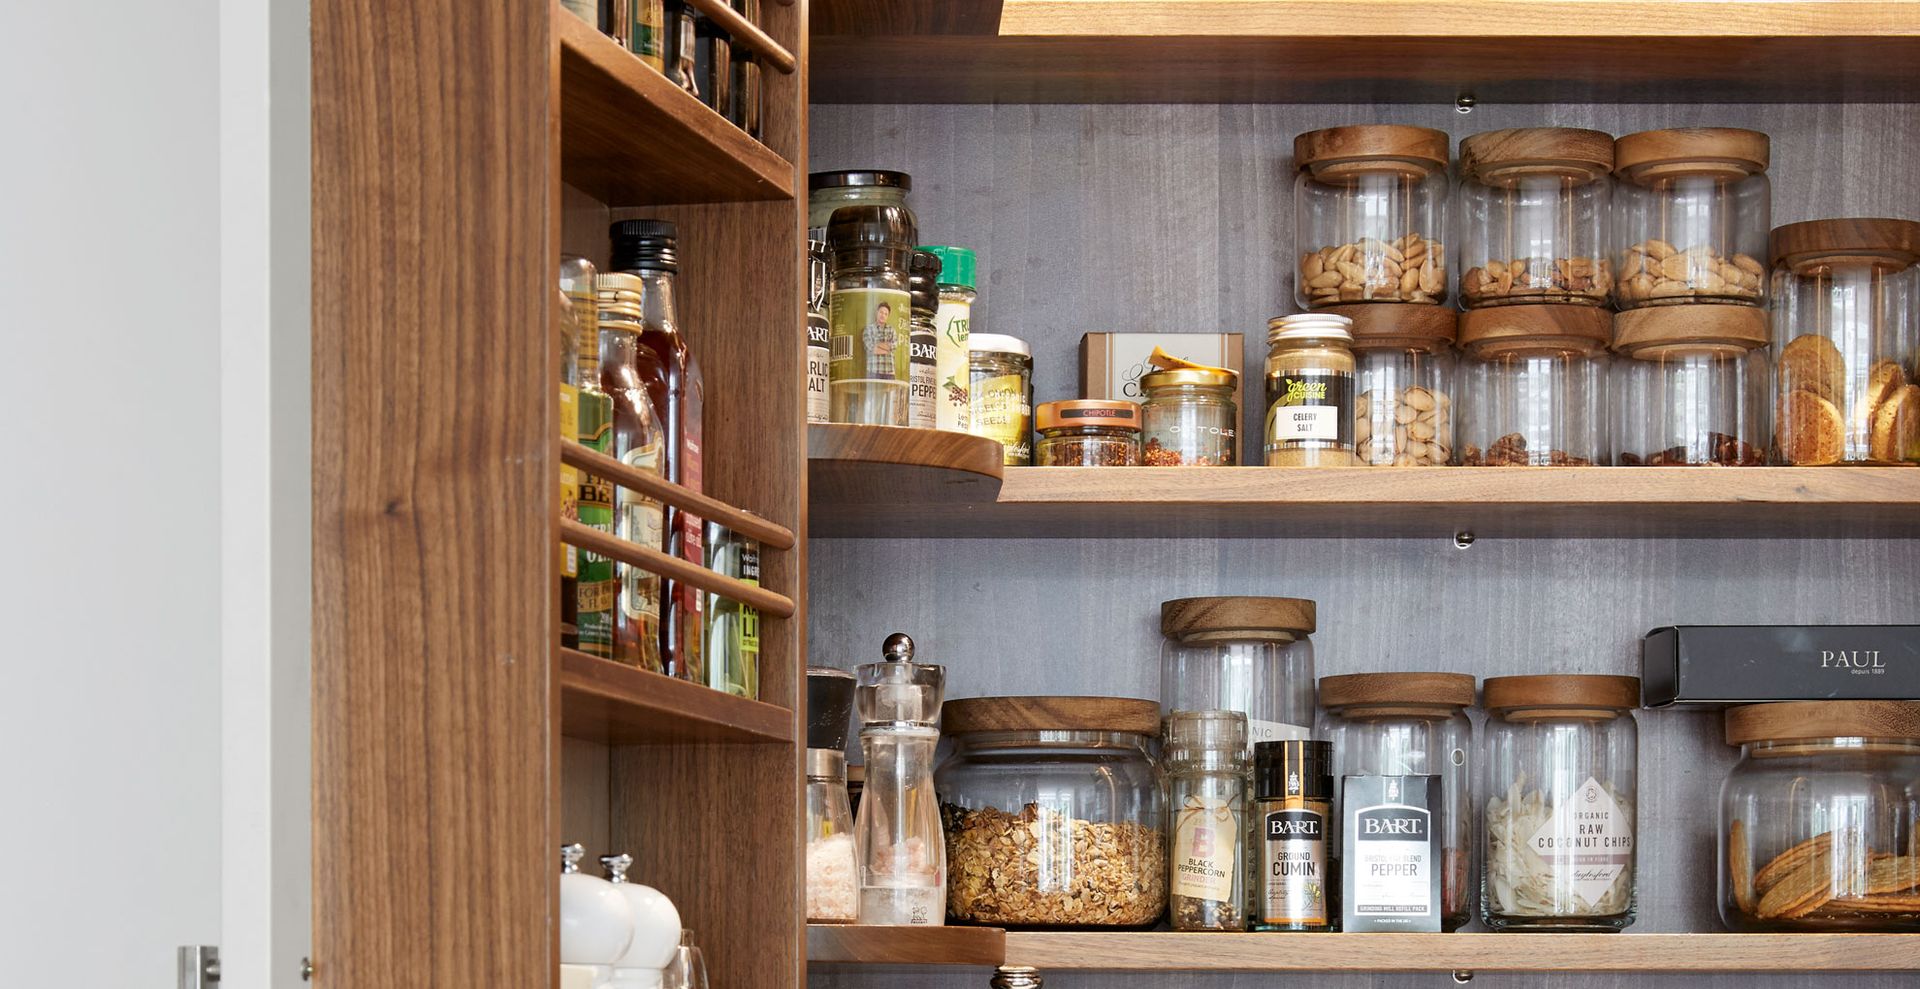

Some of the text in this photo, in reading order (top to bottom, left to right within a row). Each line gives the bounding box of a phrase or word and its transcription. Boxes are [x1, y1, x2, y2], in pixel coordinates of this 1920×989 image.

[807, 326, 829, 344] ART
[911, 342, 936, 359] BAR
[808, 378, 825, 393] ALT
[911, 383, 936, 400] PEPPE
[1287, 379, 1327, 402] green
[1294, 391, 1326, 399] CUISINE
[1293, 413, 1317, 422] CELERY
[1297, 424, 1312, 432] SALT
[1821, 650, 1887, 668] PAUL
[1579, 824, 1604, 834] RAW
[1538, 836, 1631, 848] COCONUT CHIPS
[1188, 857, 1214, 868] BLACK
[1277, 851, 1311, 861] GROUND
[1177, 864, 1226, 878] PEPPERCORN
[1272, 861, 1315, 876] CUMIN
[1371, 863, 1417, 876] PEPPER
